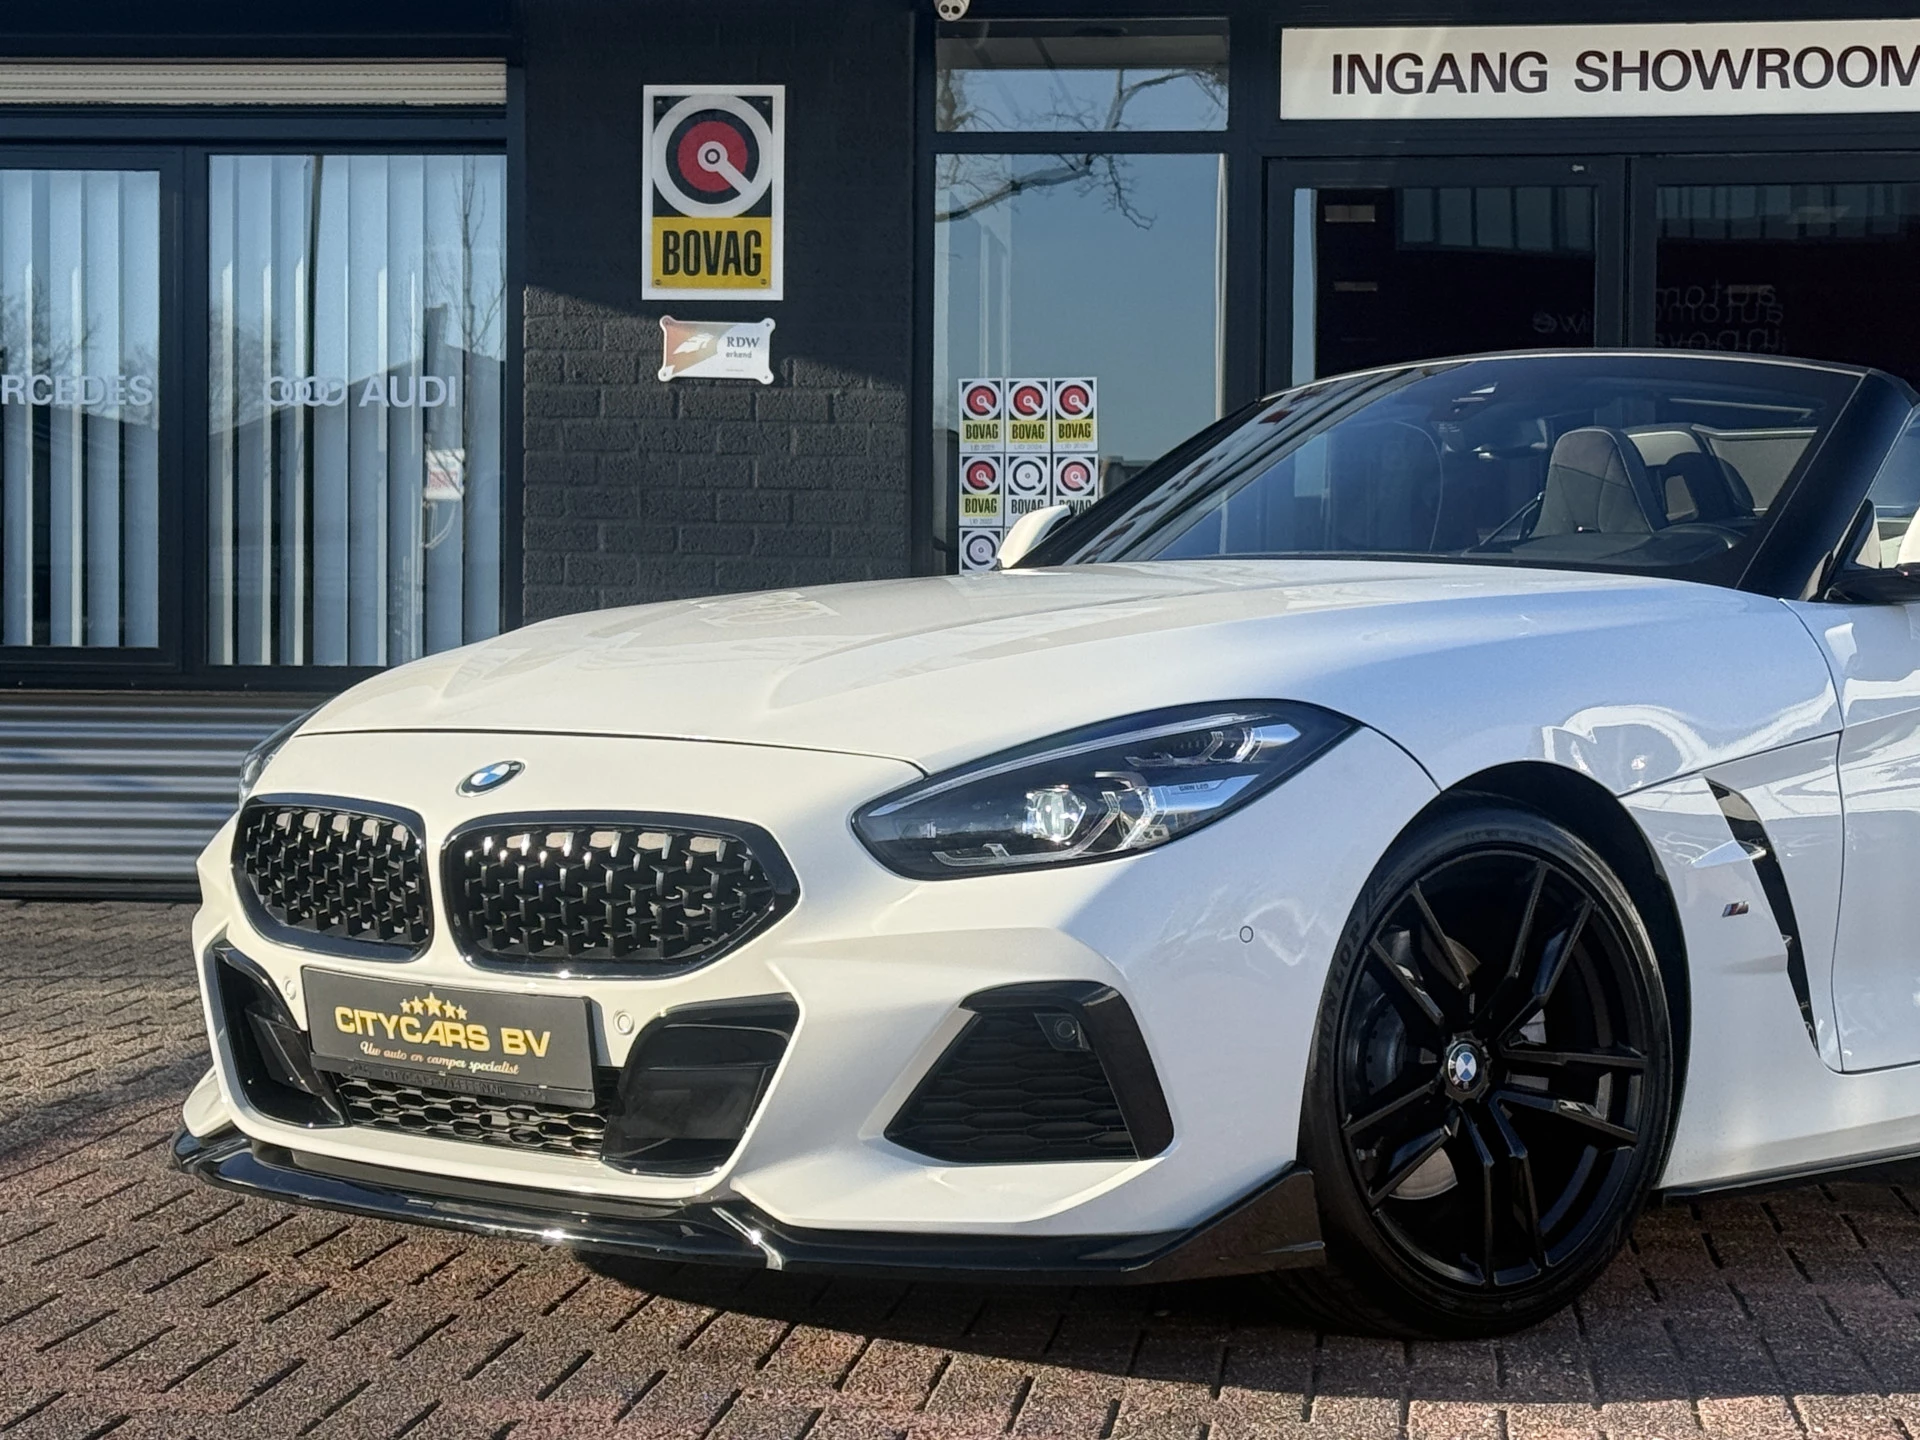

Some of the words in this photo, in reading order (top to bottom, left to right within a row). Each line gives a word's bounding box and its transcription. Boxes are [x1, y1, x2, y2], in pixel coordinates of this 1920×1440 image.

[1332, 51, 1548, 95] INGANG
[1574, 45, 1920, 93] SHOWROOM
[662, 229, 761, 276] BOVAG
[726, 337, 760, 348] RDW
[359, 375, 456, 407] AUDI
[966, 423, 999, 440] BOVAG
[1012, 423, 1045, 440] BOVAG
[1059, 423, 1091, 439] BOVAG
[965, 498, 997, 514] BOVAG
[334, 1006, 491, 1051] CITYCARS
[500, 1027, 551, 1058] BV
[360, 1041, 381, 1056] Uw
[383, 1049, 407, 1061] auto
[410, 1053, 424, 1062] en
[468, 1060, 519, 1075] specialist
